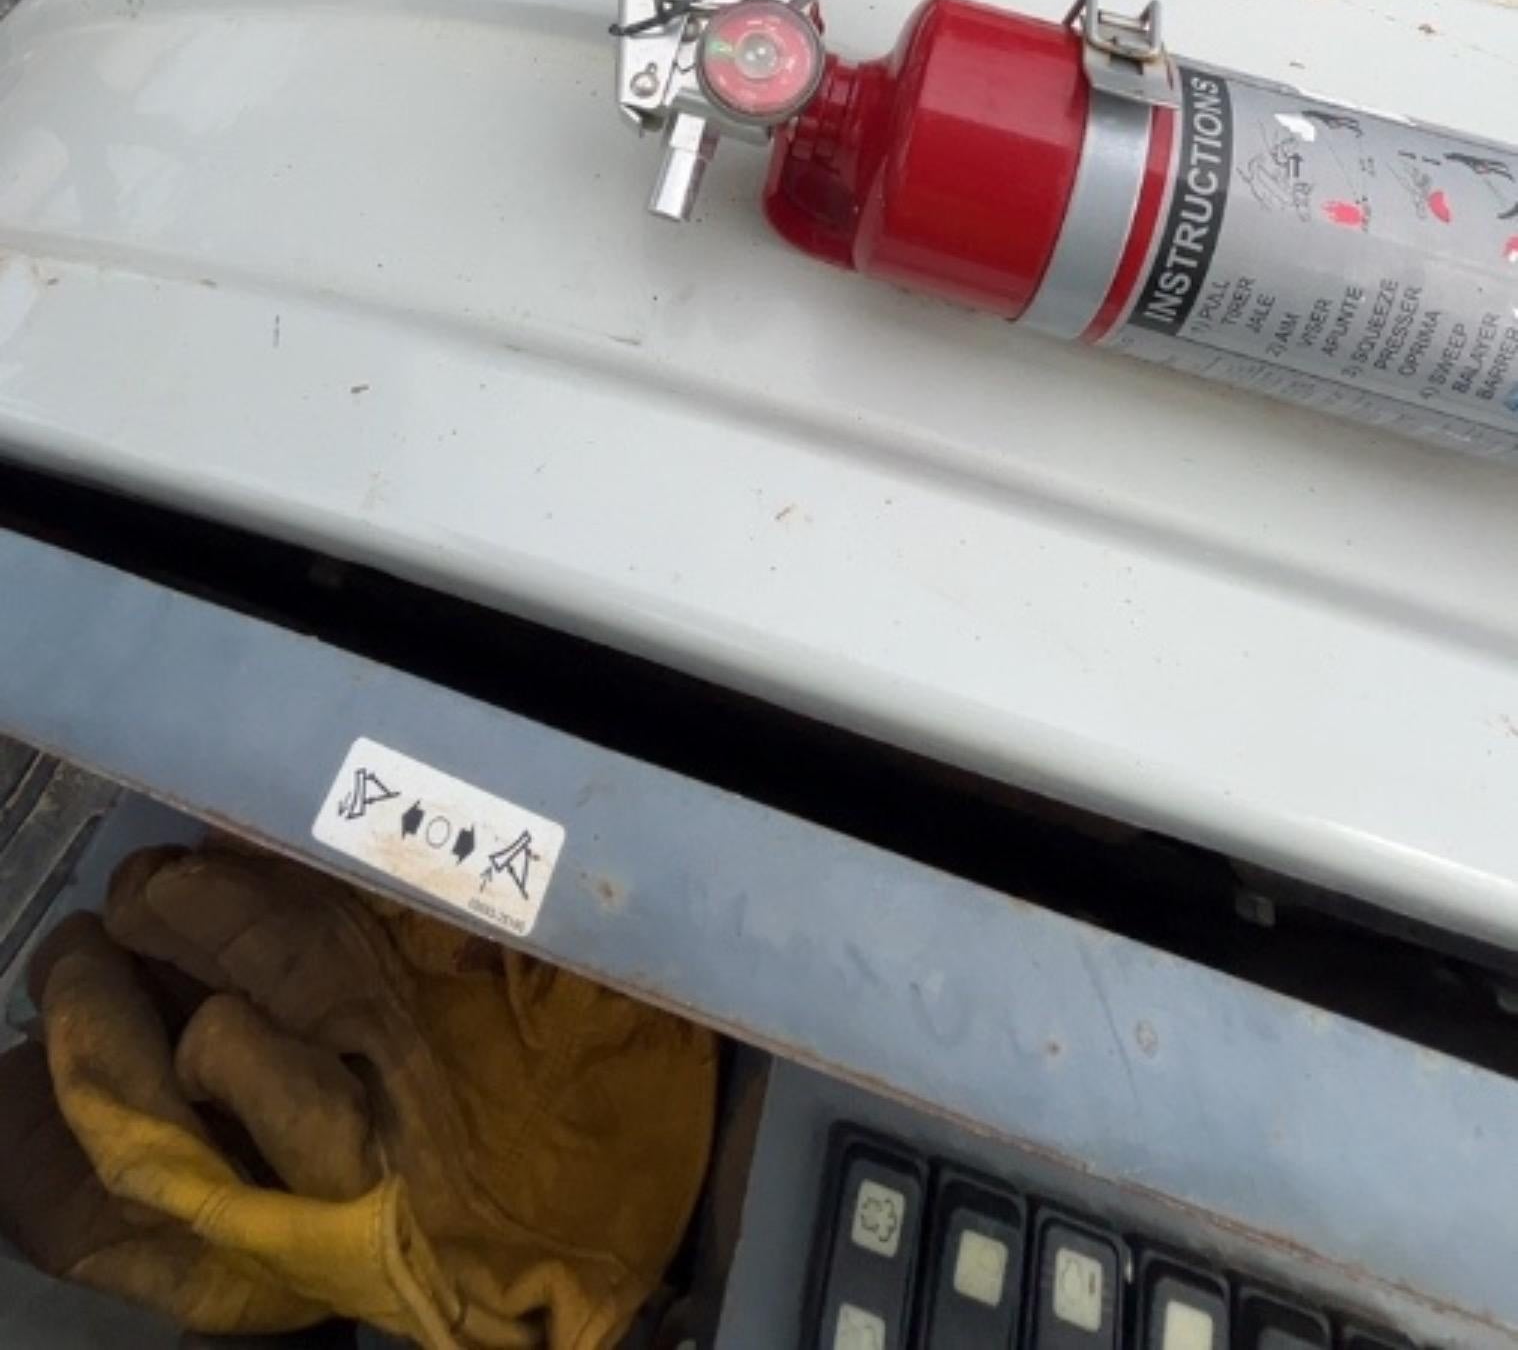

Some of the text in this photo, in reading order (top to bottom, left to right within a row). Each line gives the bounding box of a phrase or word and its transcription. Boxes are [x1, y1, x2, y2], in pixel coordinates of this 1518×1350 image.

[1144, 76, 1224, 323] INSTRUCTIONS
[1321, 286, 1363, 358] APUNTE
[1350, 278, 1399, 364] SQUEEZE
[1373, 287, 1423, 371] PRESSER
[1397, 310, 1441, 377] OPRIMA
[1427, 323, 1467, 386] SWEEP
[1451, 312, 1501, 394] BALAYER
